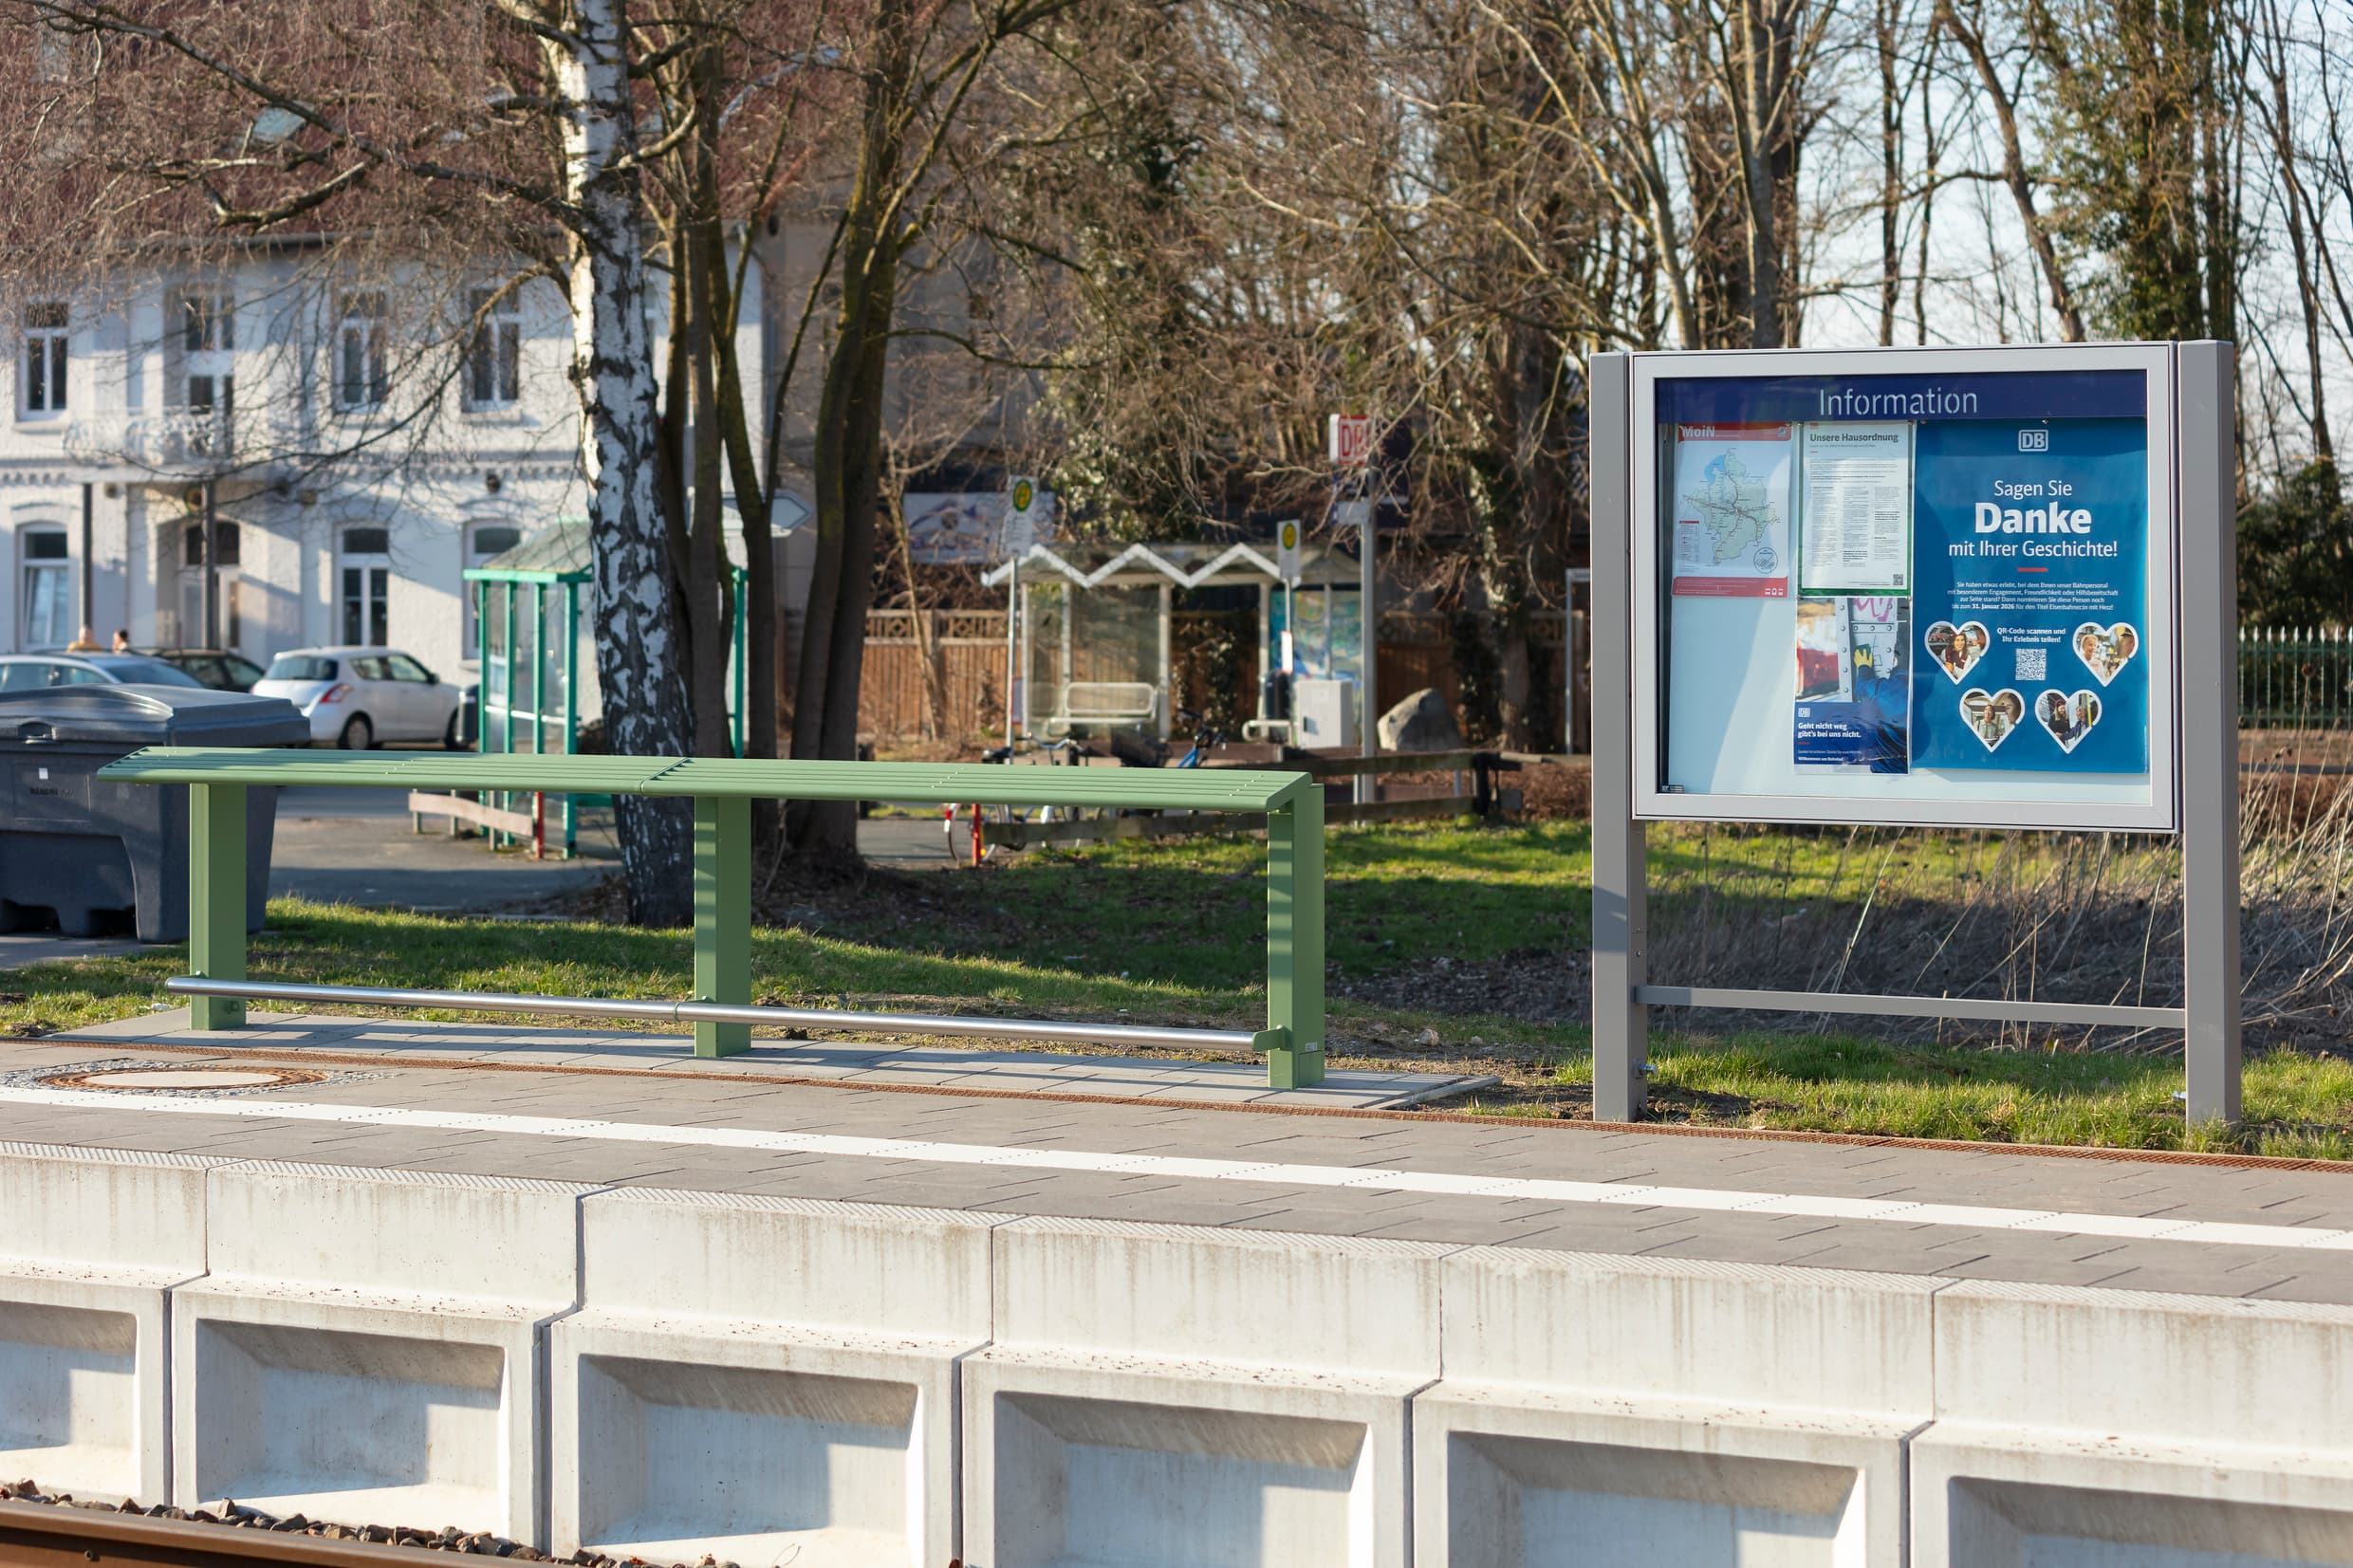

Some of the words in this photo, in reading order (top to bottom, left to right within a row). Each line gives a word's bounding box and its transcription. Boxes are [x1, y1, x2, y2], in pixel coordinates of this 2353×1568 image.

[1819, 386, 1978, 415] Information
[1682, 425, 1715, 437] MoiN
[1809, 434, 1840, 442] Unsere
[1842, 433, 1899, 443] Hausordnung
[2022, 433, 2046, 449] DB
[1994, 480, 2043, 501] Sagen
[2047, 480, 2073, 497] Sie
[1974, 501, 2093, 534] Danke
[1949, 541, 1975, 557] mit
[1979, 541, 2019, 557] Ihrer
[2023, 541, 2118, 557] Geschichte!
